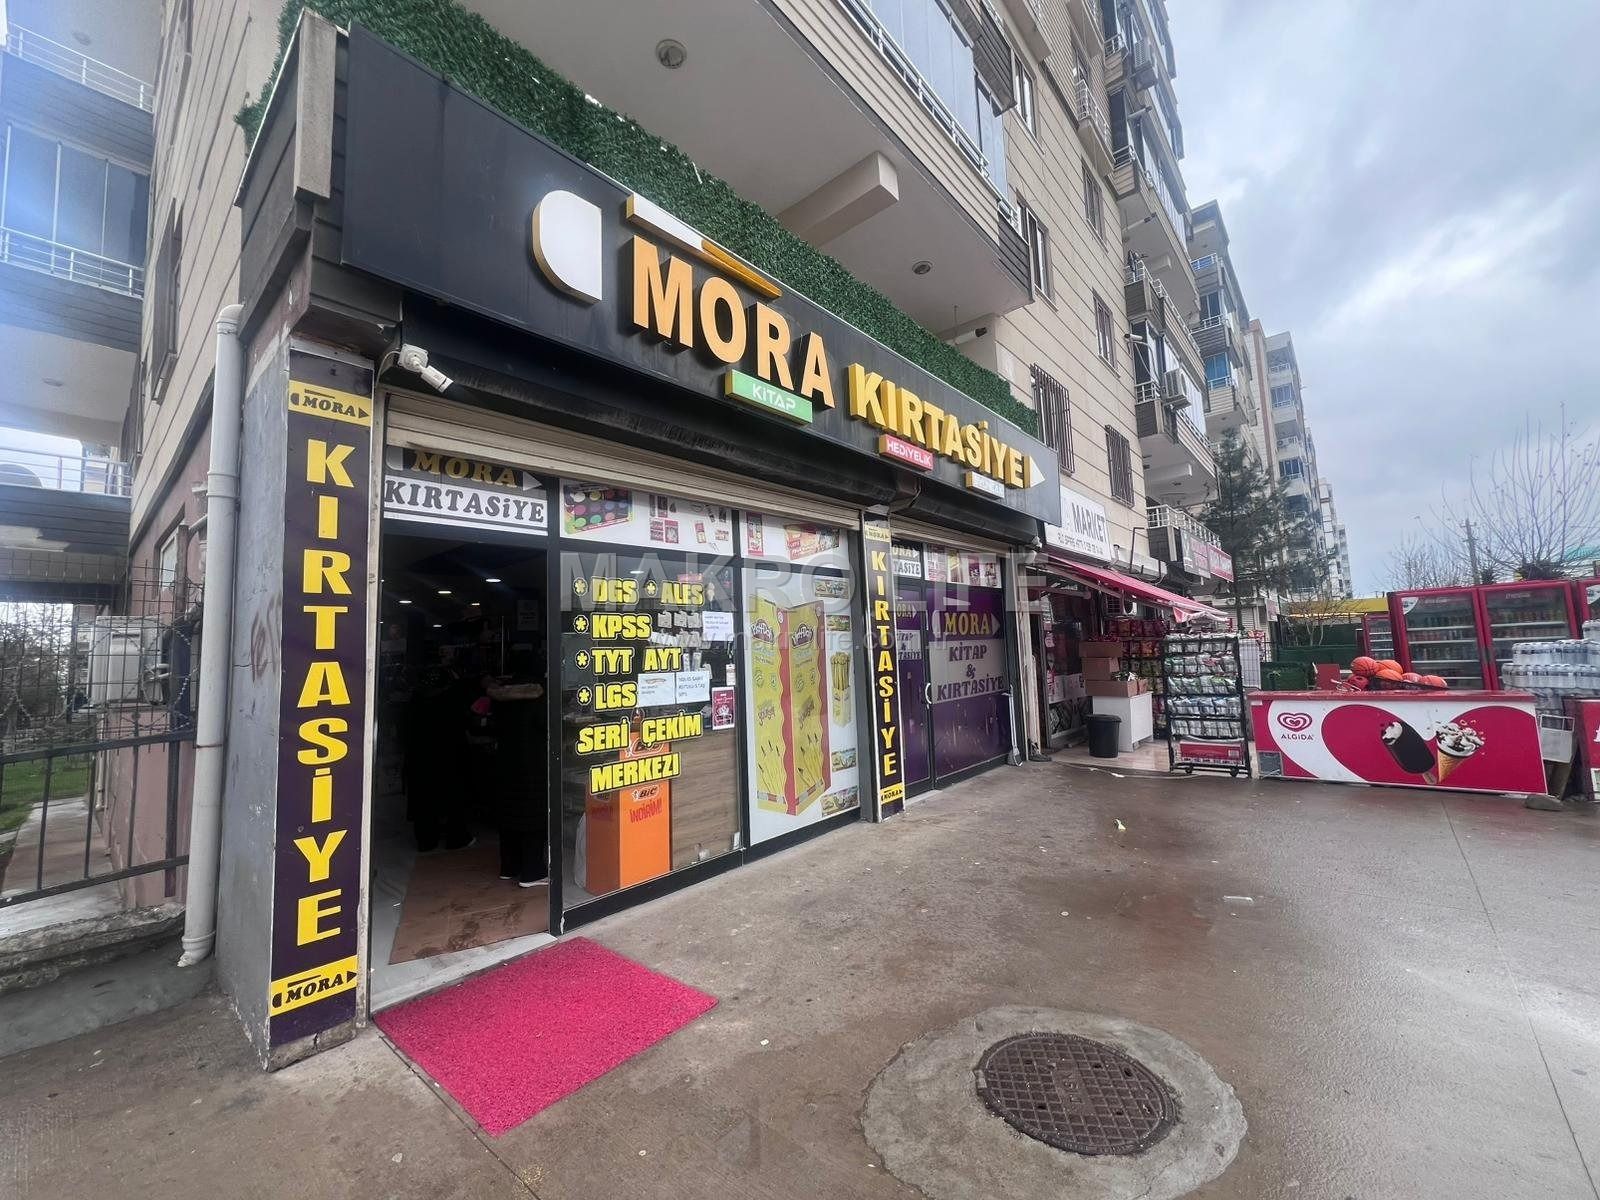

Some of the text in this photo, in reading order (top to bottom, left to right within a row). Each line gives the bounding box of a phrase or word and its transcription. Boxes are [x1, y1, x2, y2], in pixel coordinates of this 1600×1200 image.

[632, 235, 835, 409] MORA
[302, 395, 355, 417] MORA
[849, 363, 1024, 488] KIRTASİYE
[411, 449, 518, 487] MORA
[1072, 502, 1108, 543] MARKET
[591, 576, 705, 606] DGS ALES
[591, 613, 651, 639] KPSS
[944, 612, 992, 636] MORA
[591, 647, 682, 674] TYT AYT
[965, 663, 977, 680] &
[594, 683, 638, 711] LGS
[1280, 733, 1314, 741] ALGIDA
[286, 975, 345, 1004] MORA
